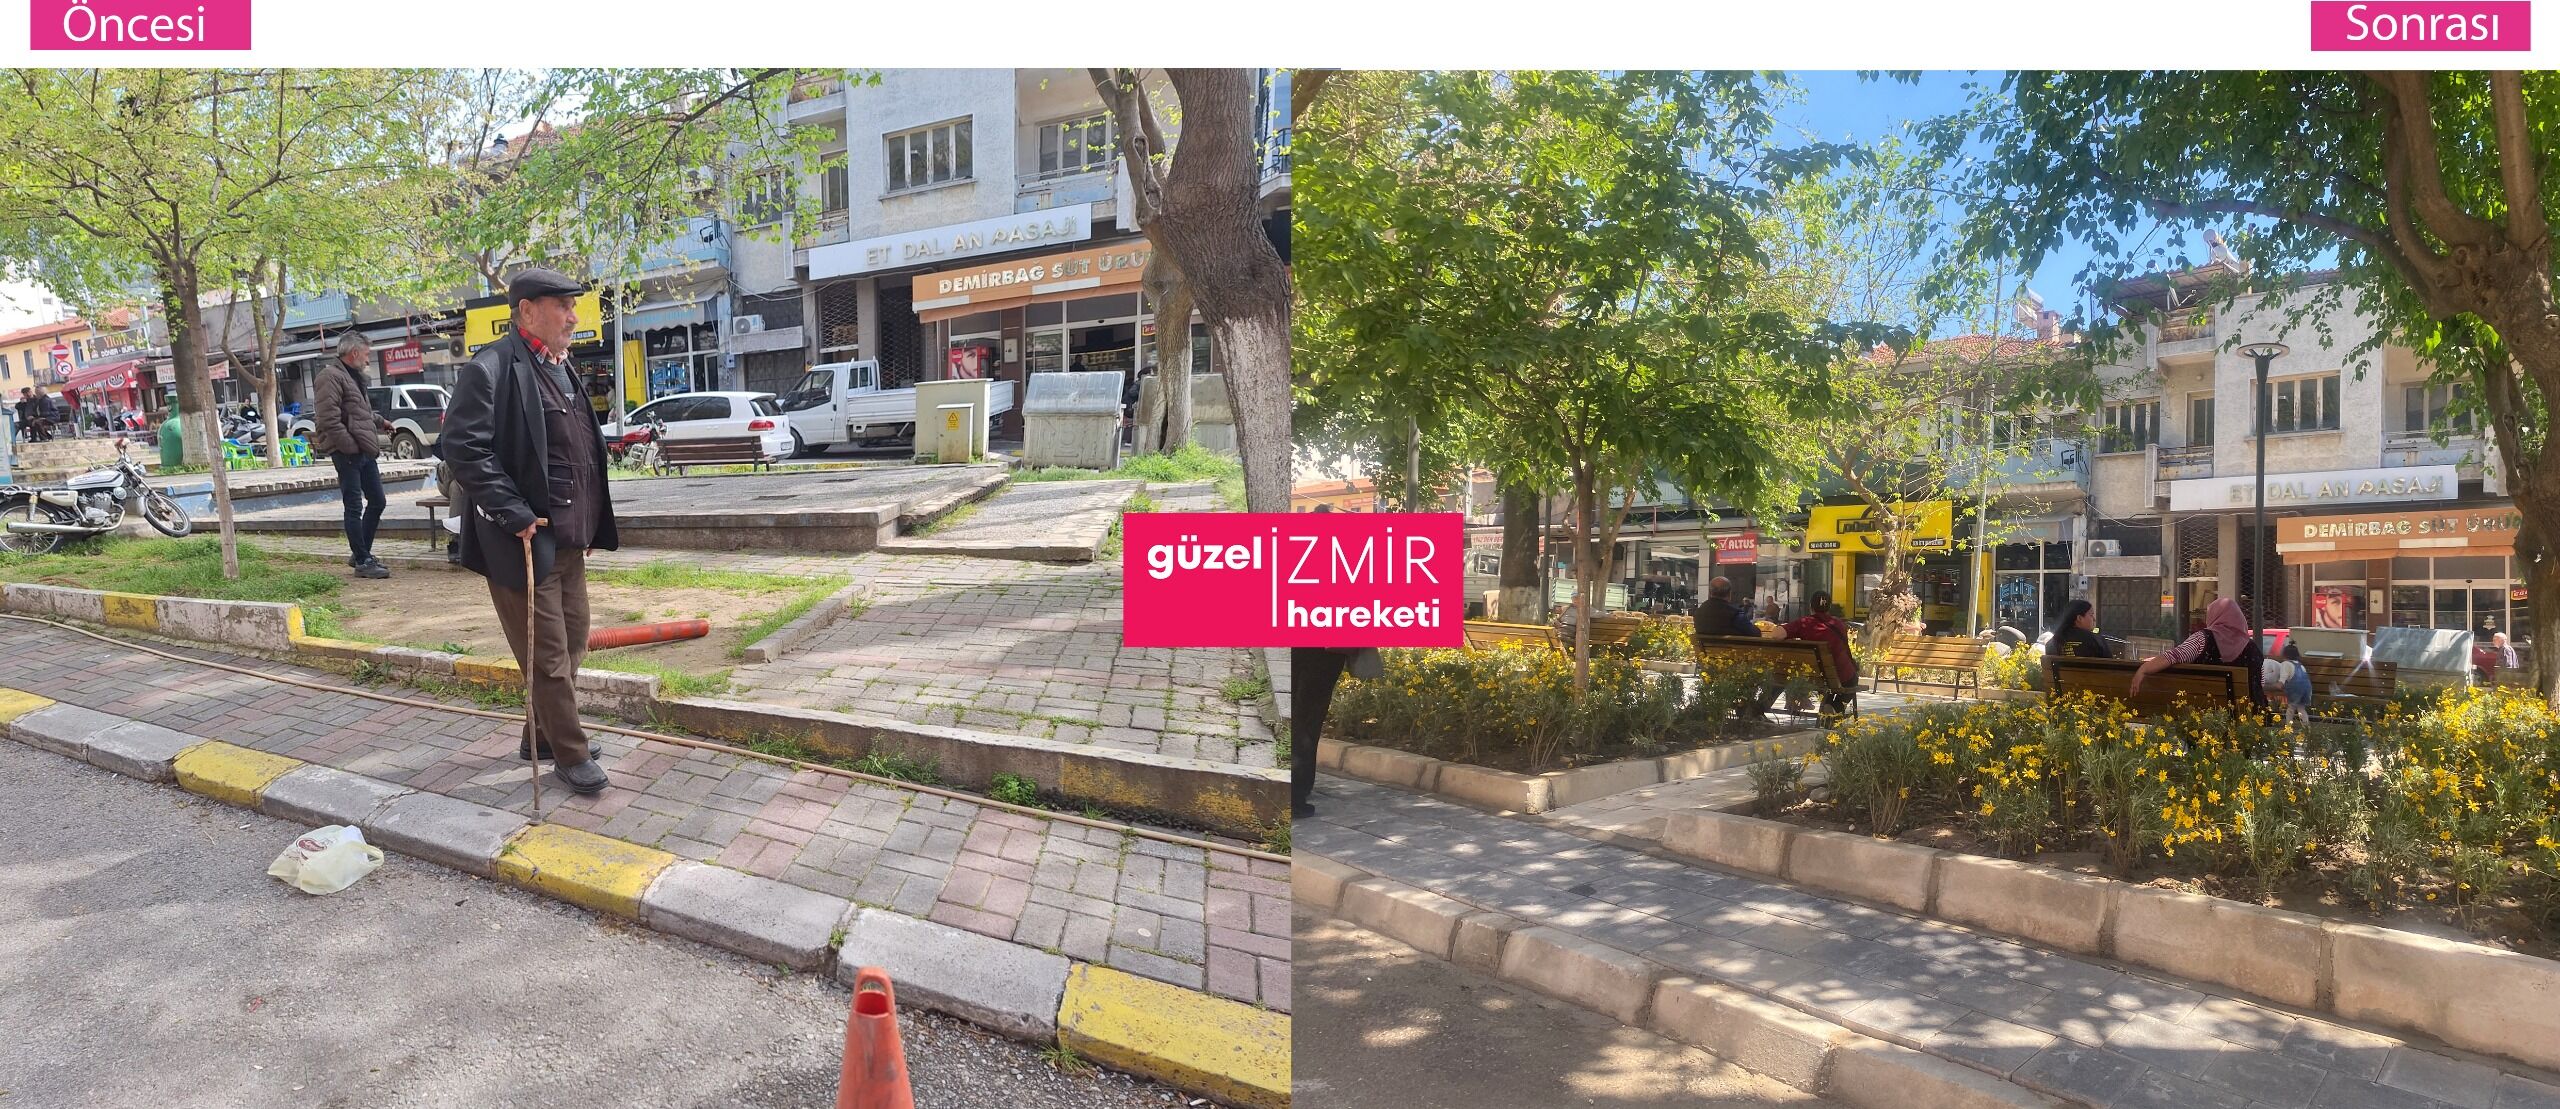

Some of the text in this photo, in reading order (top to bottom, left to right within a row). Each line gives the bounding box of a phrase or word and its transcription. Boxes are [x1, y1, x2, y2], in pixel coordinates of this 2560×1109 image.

[867, 244, 891, 265] ET
[939, 259, 1045, 294] DEMİRBAĞ
[394, 347, 419, 360] ALTUS
[2230, 485, 2256, 502] ET
[1728, 539, 1755, 550] ALTUS
